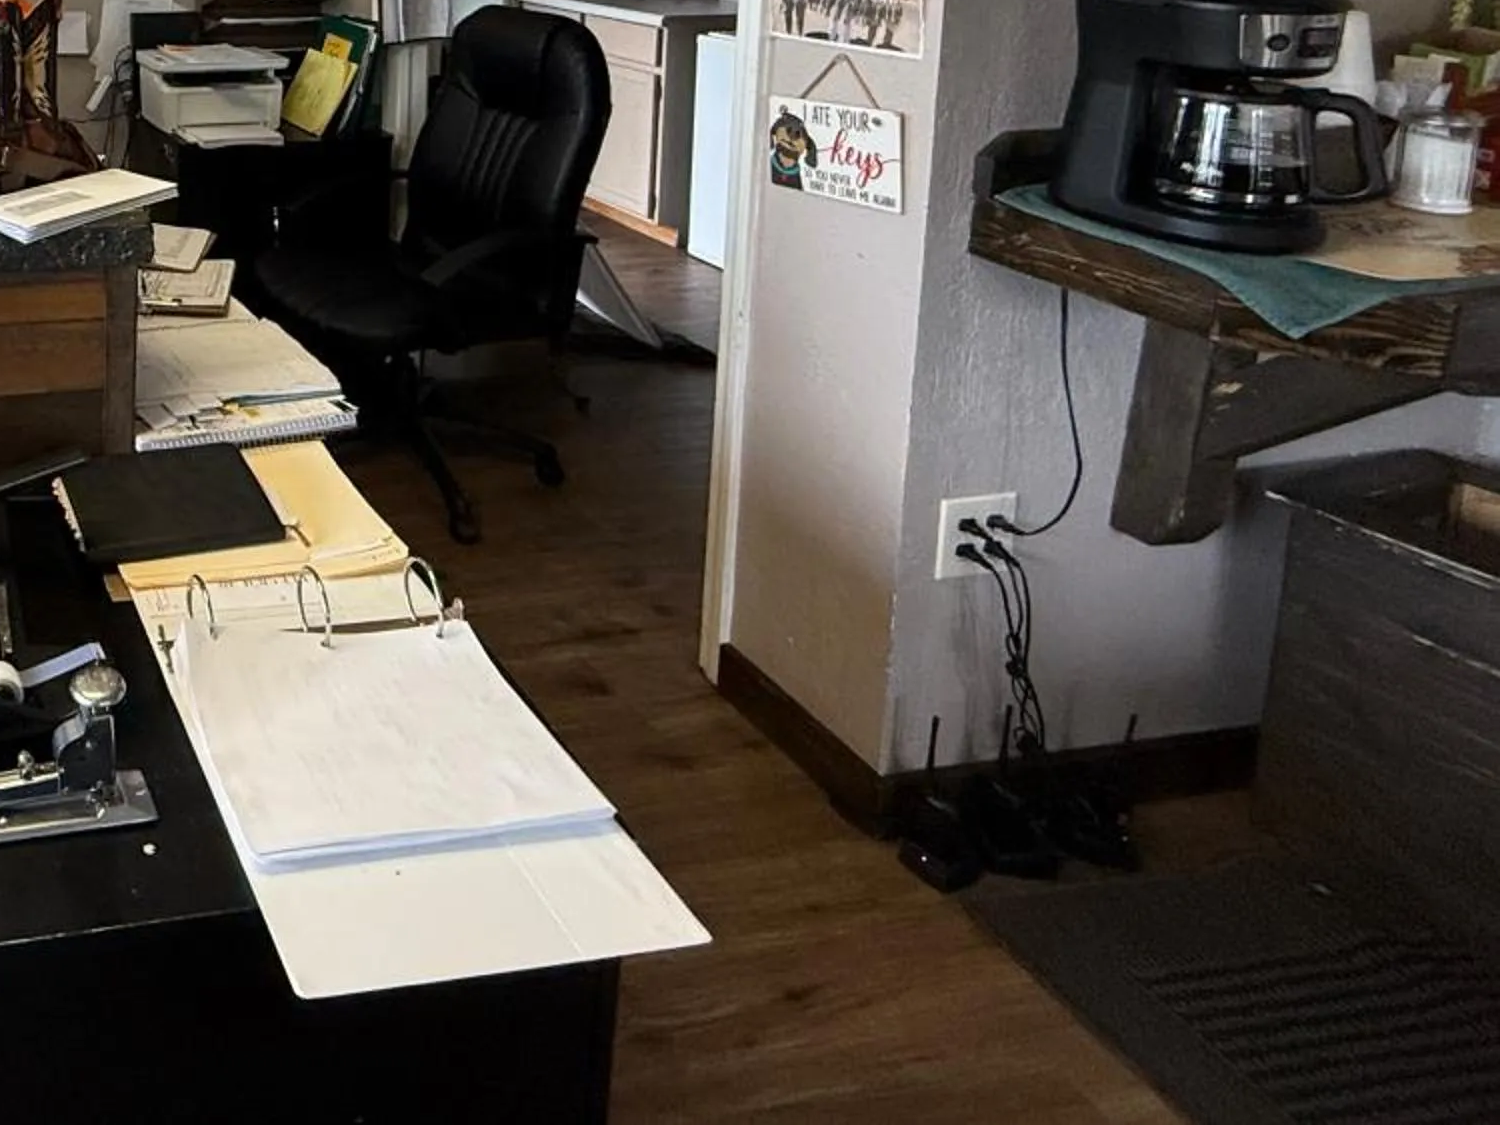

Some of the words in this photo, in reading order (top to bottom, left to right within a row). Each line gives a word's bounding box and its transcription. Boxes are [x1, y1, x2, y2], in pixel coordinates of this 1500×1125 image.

[811, 106, 831, 127] ATE
[836, 108, 871, 133] YOUR
[830, 127, 884, 189] keys
[815, 169, 828, 181] YOU
[829, 172, 851, 185] NEVER
[827, 184, 836, 195] TO
[859, 190, 869, 202] ME
